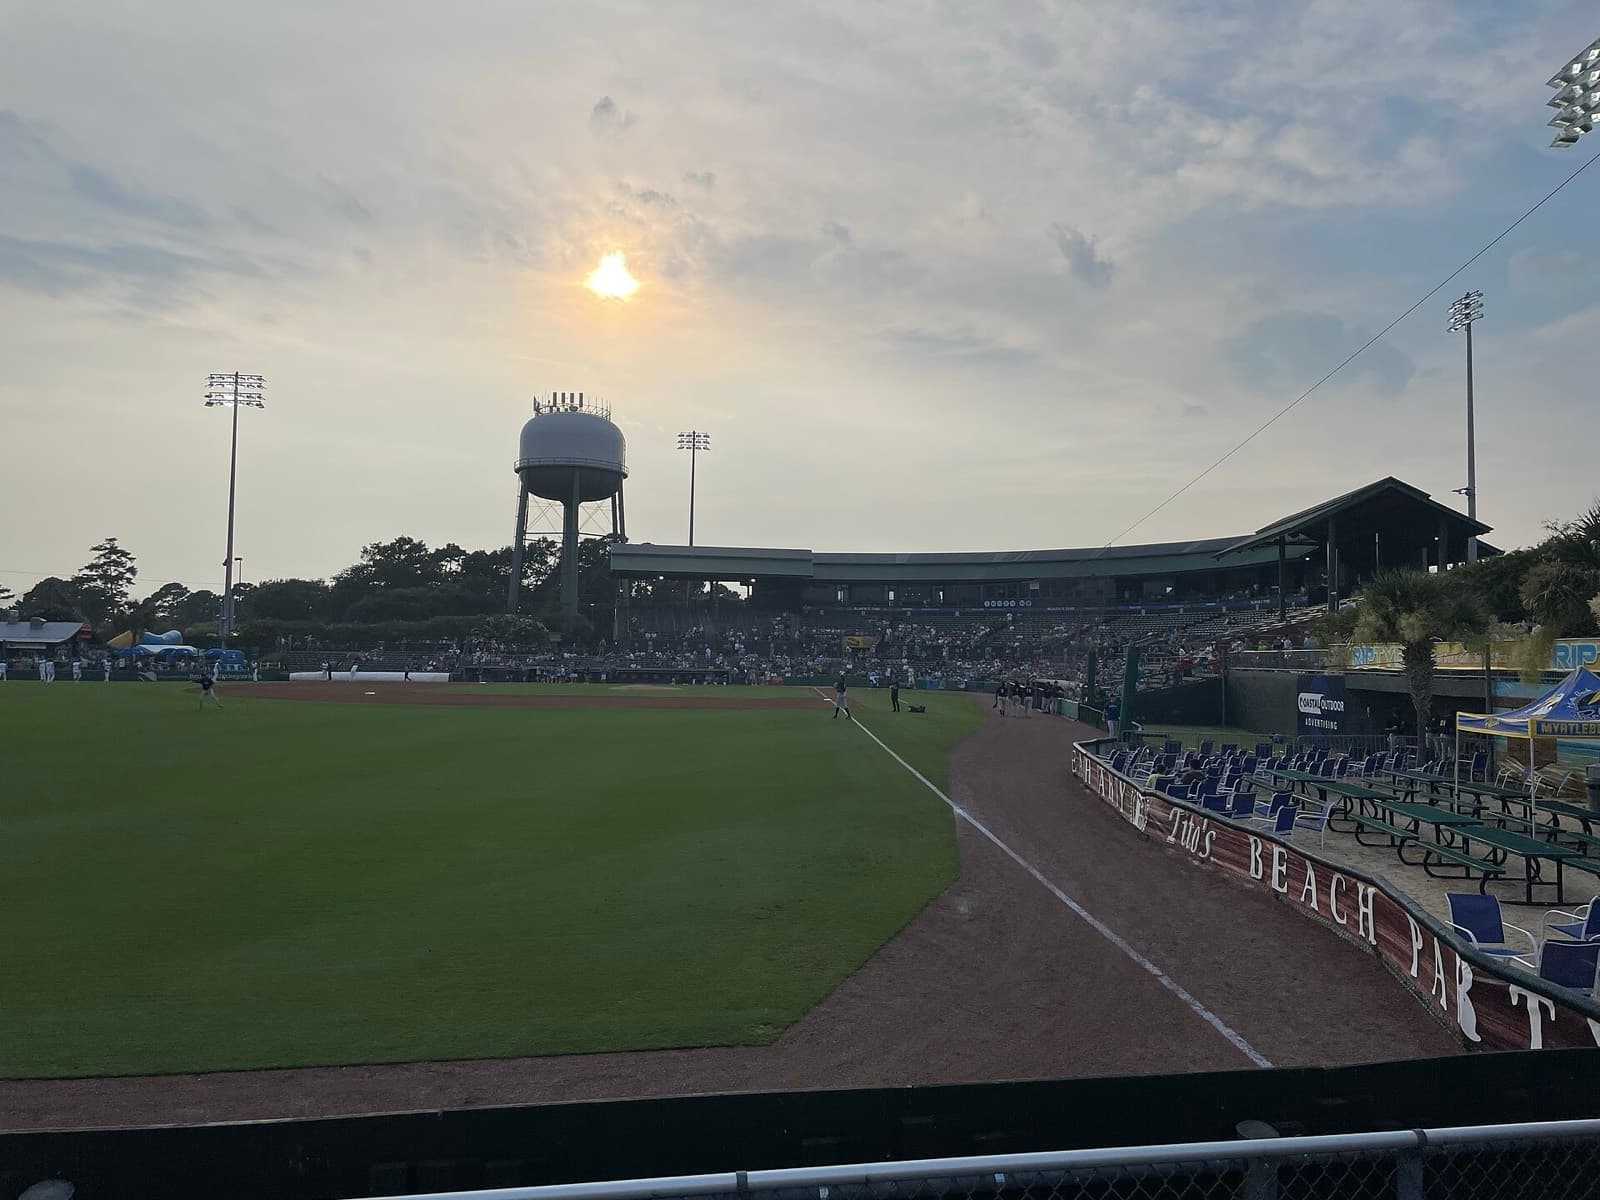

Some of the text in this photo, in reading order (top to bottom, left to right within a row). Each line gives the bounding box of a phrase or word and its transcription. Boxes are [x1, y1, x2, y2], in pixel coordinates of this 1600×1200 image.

[1305, 717, 1338, 730] ADVERTISING
[1166, 807, 1216, 858] Tito's
[1248, 835, 1377, 945] BEACH
